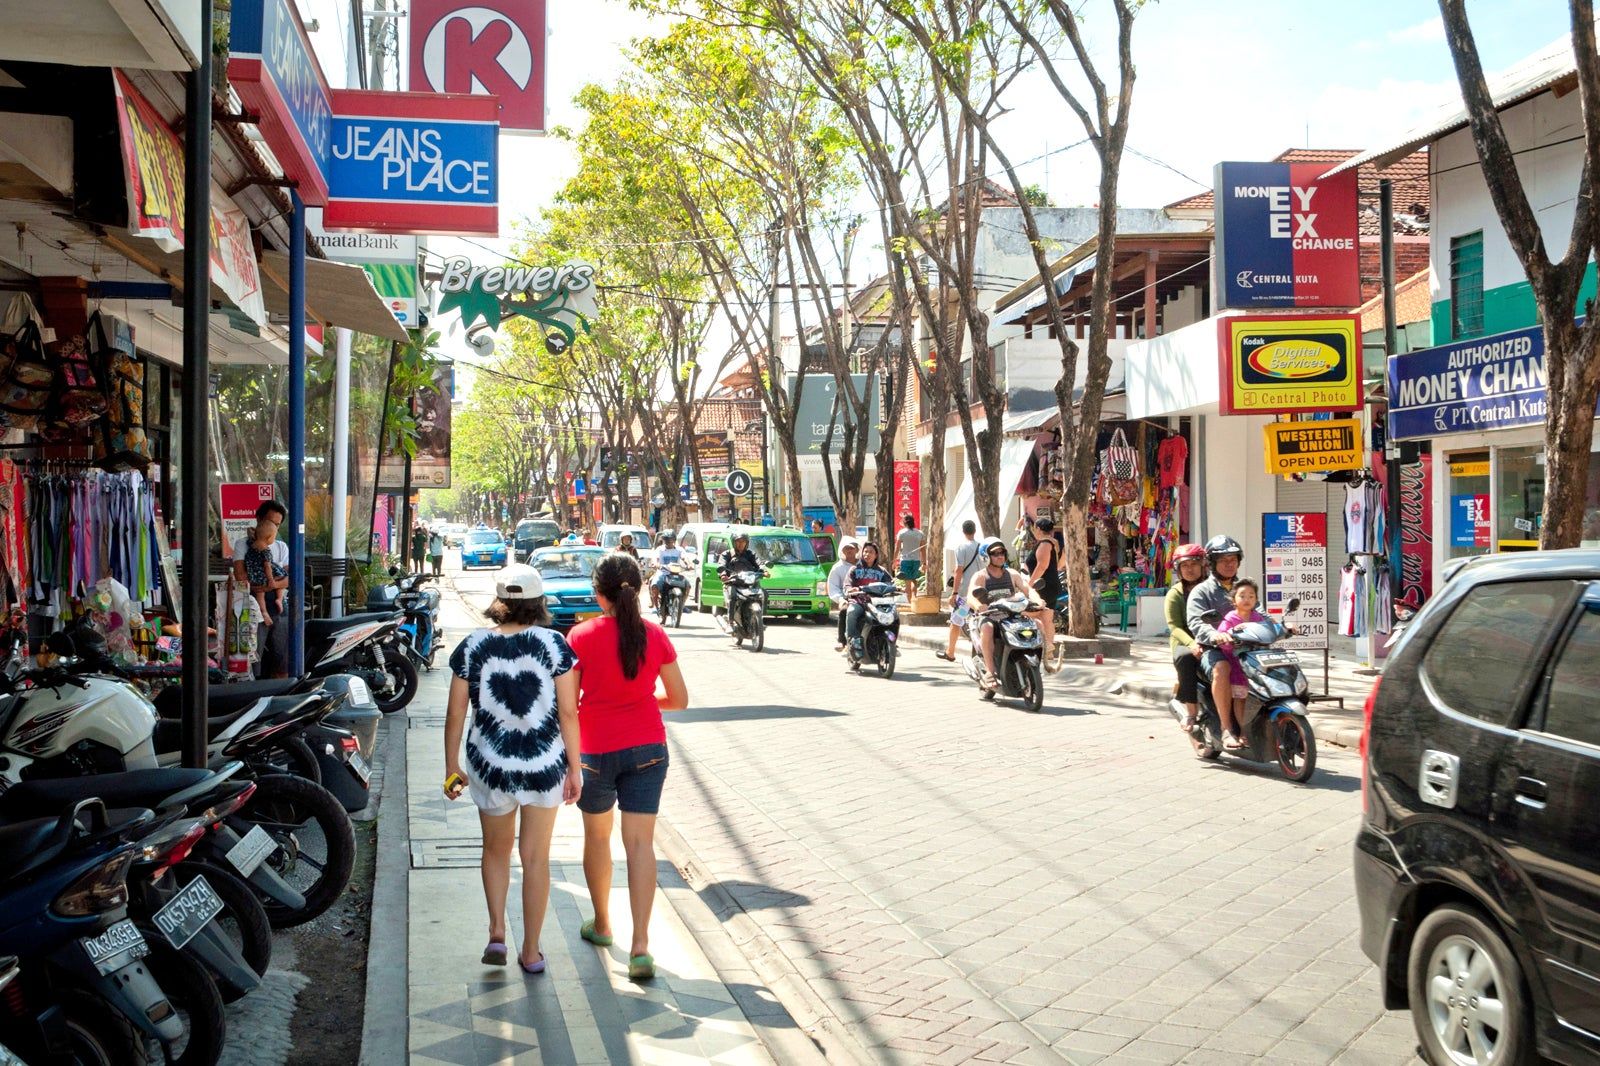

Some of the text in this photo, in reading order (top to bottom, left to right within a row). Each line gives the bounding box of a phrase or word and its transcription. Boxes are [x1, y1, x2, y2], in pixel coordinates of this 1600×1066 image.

[271, 1, 301, 112] JEANS
[332, 126, 442, 164] JEANS
[383, 158, 490, 195] PLACE
[1234, 186, 1318, 211] MONEY
[1269, 213, 1319, 238] EX
[314, 233, 400, 250] mataBank
[1292, 238, 1354, 250] CHANGE
[440, 255, 595, 294] Brewers
[1252, 274, 1319, 284] CENTRAL KUTA
[1243, 337, 1265, 346] Kodak
[1273, 346, 1322, 359] Digital
[1447, 336, 1532, 370] AUTHORIZED
[1270, 357, 1326, 370] Services
[1399, 355, 1546, 408] MONEY CHAN
[1261, 390, 1347, 405] Central Photo
[1470, 400, 1515, 424] Central
[1279, 428, 1342, 443] WESTERN
[1299, 439, 1342, 452] UNION
[1279, 454, 1356, 468] OPEN DAILY
[1474, 520, 1491, 528] CHANG
[1301, 556, 1324, 567] 9485
[1301, 573, 1324, 584] 9865
[1298, 590, 1324, 601] 11640
[1302, 607, 1324, 618] 7565
